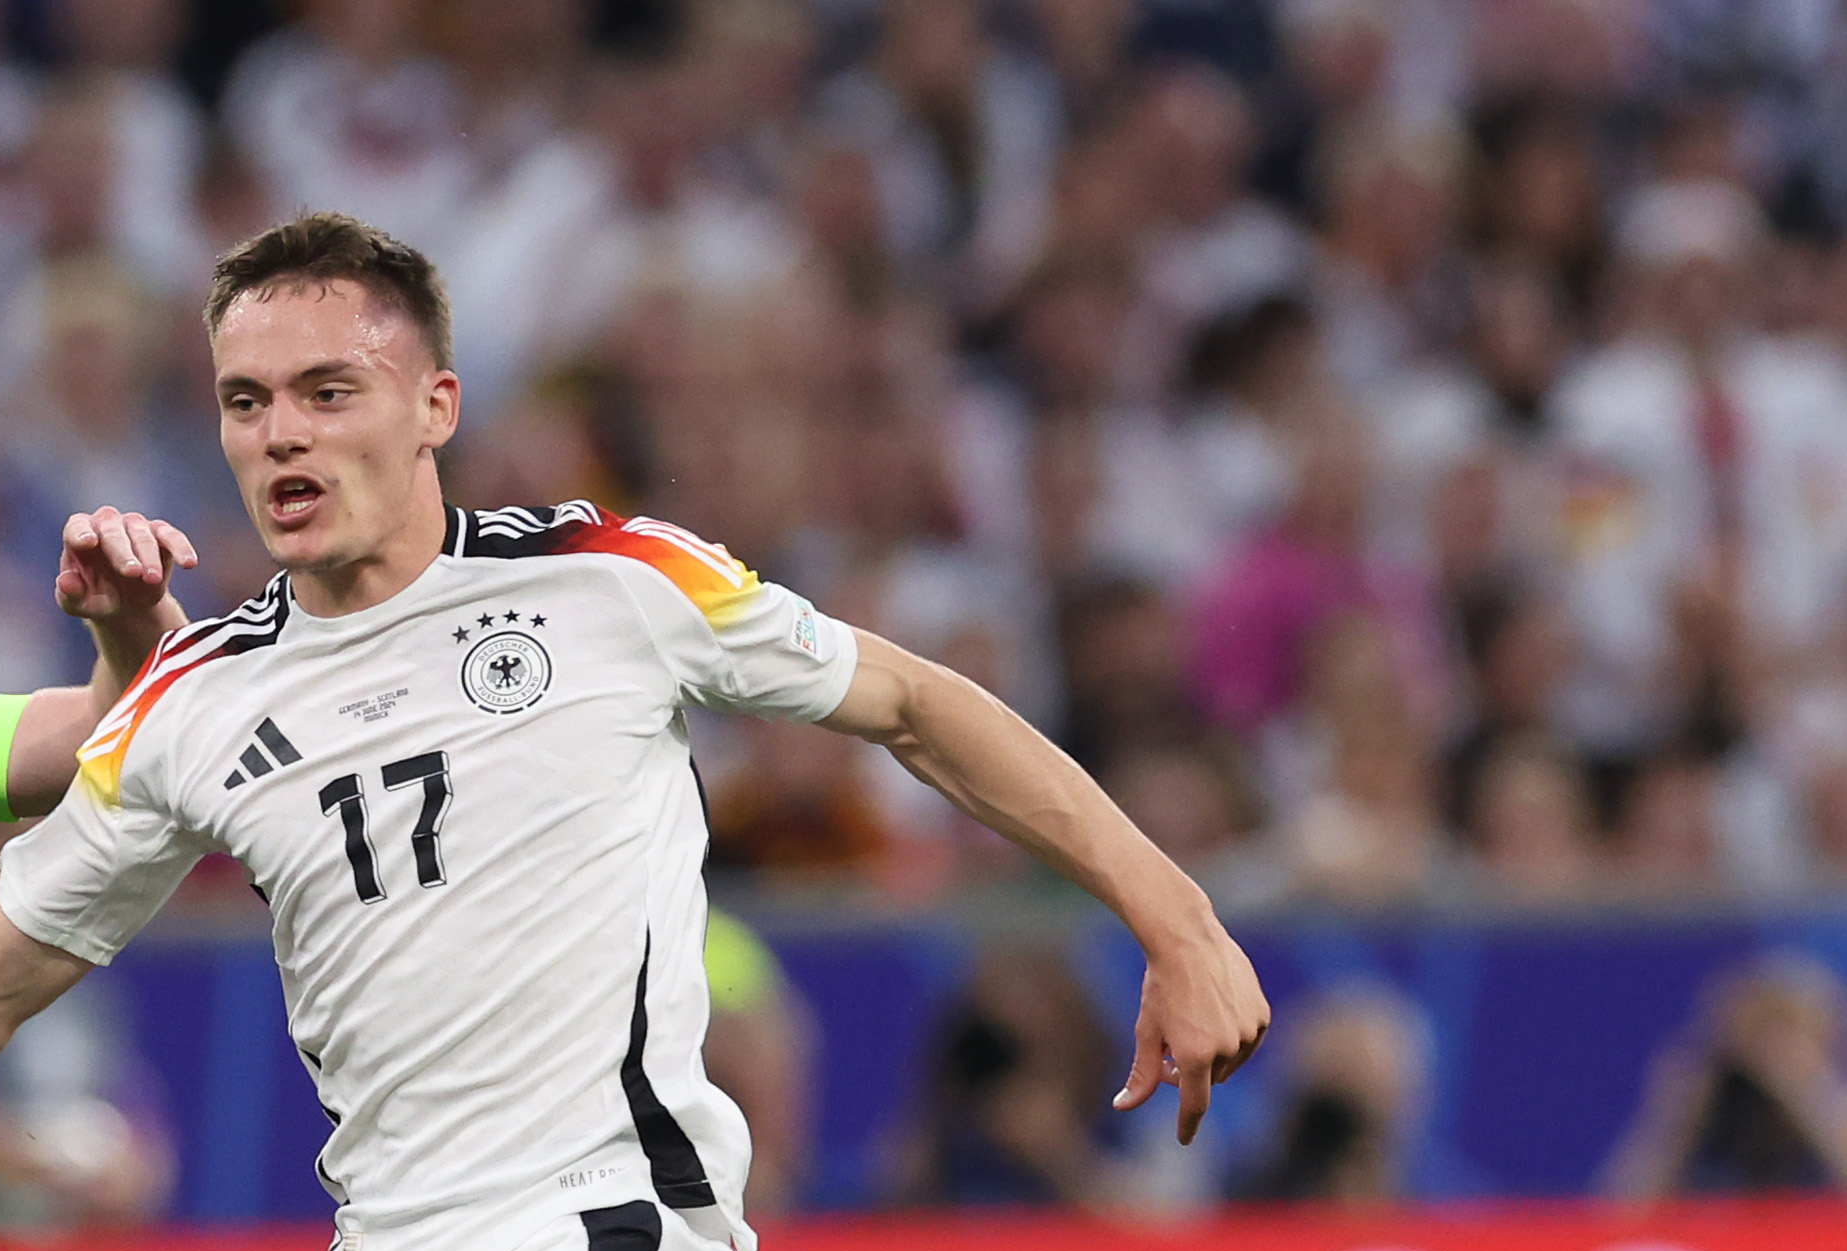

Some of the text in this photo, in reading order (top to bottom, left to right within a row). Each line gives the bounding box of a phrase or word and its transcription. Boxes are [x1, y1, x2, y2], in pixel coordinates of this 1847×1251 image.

[478, 641, 529, 662] DEUTSCHER
[377, 687, 409, 703] SCOTLAND
[318, 751, 453, 905] 17
[559, 1171, 593, 1188] HEAT
